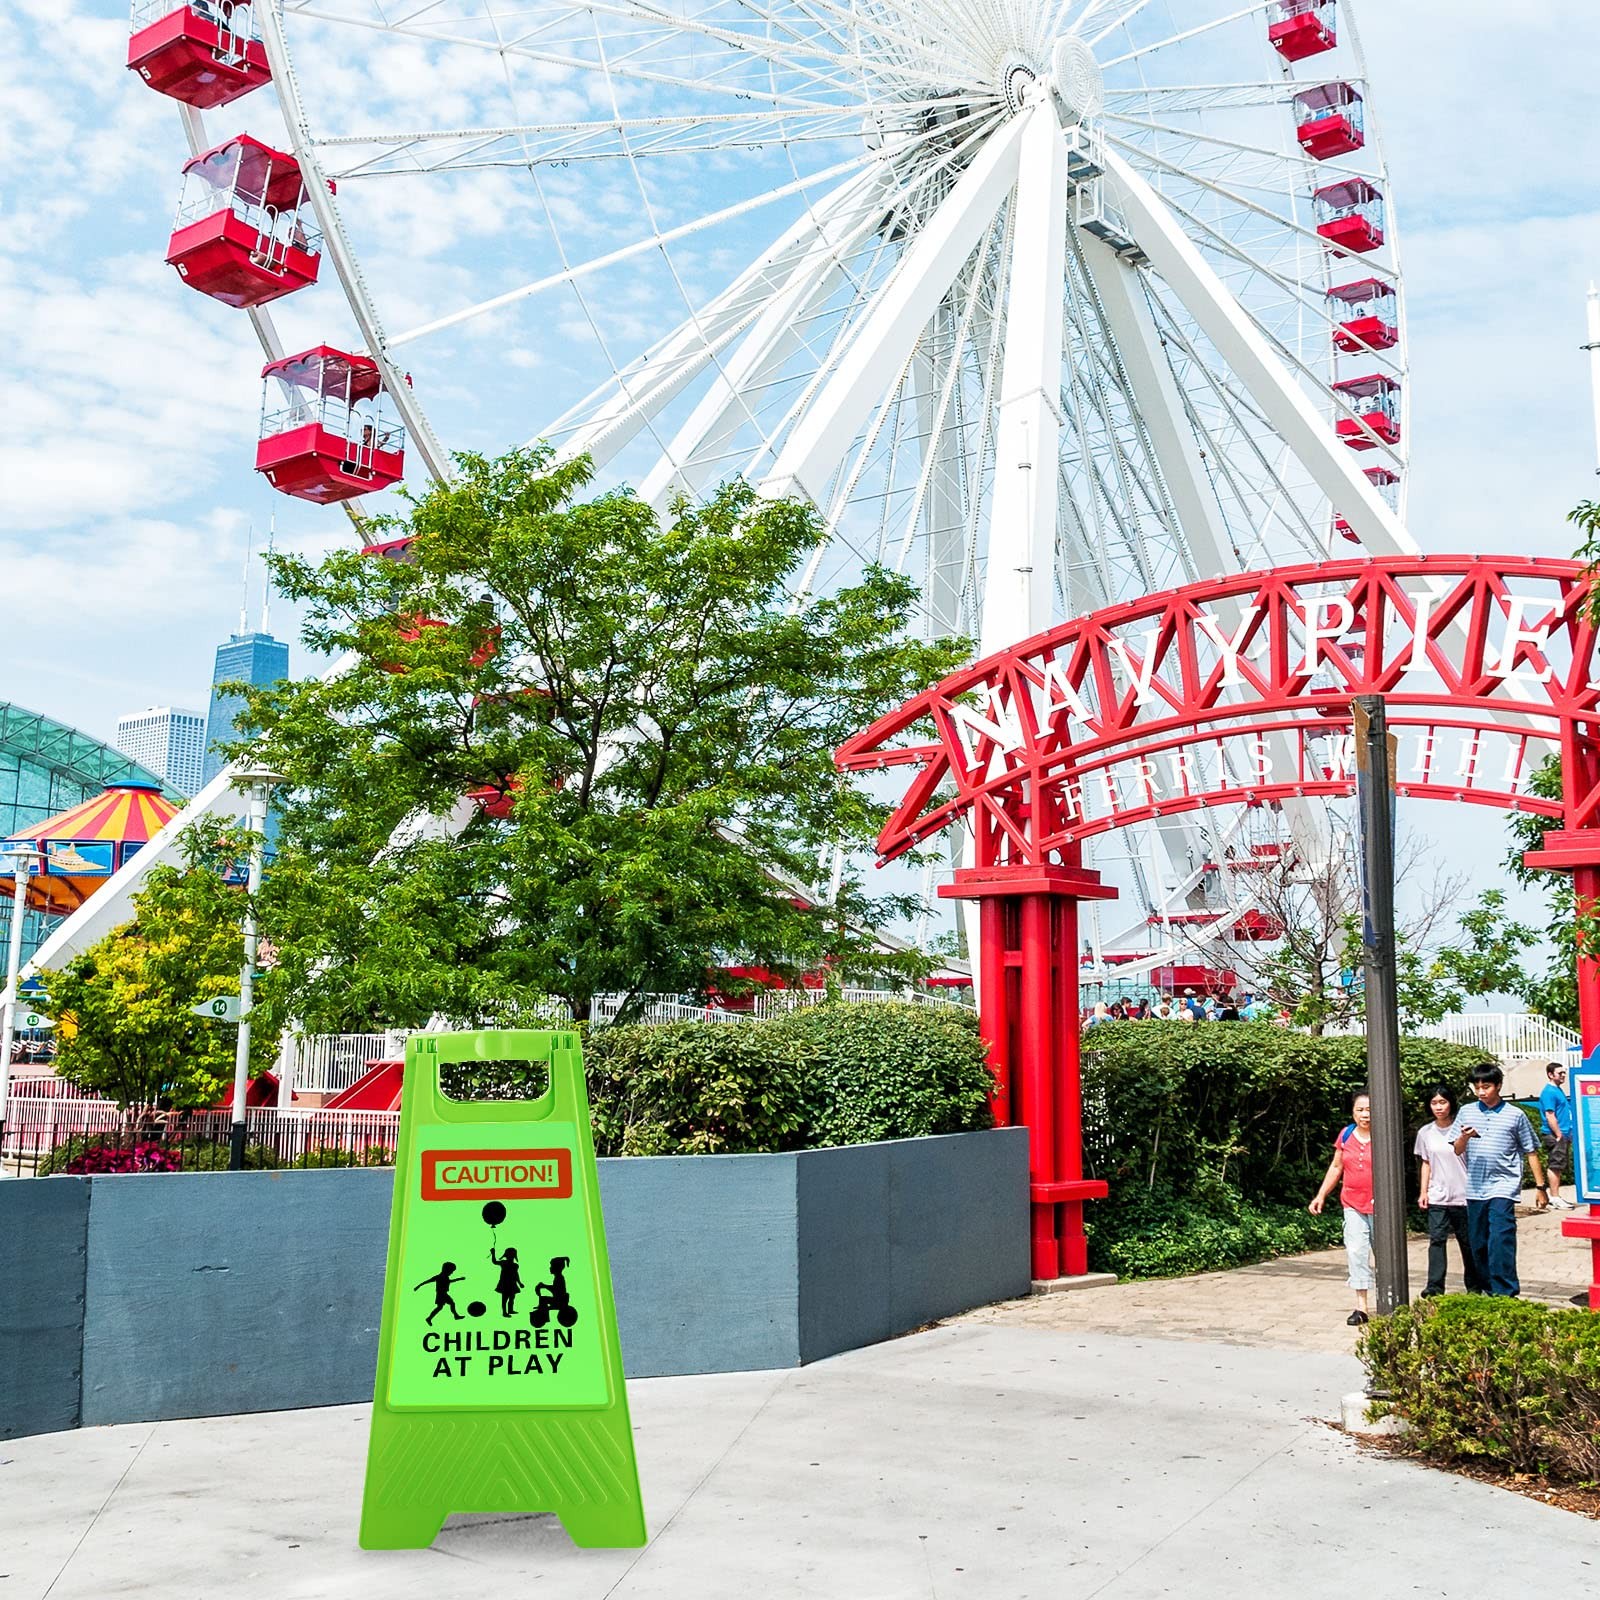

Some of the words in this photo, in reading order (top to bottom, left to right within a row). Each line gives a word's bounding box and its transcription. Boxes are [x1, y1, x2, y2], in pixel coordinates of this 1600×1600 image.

[140, 66, 153, 80] 5
[177, 264, 189, 277] 6
[1338, 339, 1349, 347] 24
[267, 470, 277, 483] 7
[1294, 591, 1600, 690] PIE
[1060, 738, 1274, 822] FERRIS
[1323, 733, 1530, 786] WEEL
[214, 1002, 226, 1013] 14
[28, 1016, 39, 1025] 13
[441, 1164, 553, 1184] CAUTION!
[422, 1328, 573, 1353] CHILDREN
[432, 1356, 472, 1378] AT
[488, 1353, 564, 1376] PLAY
